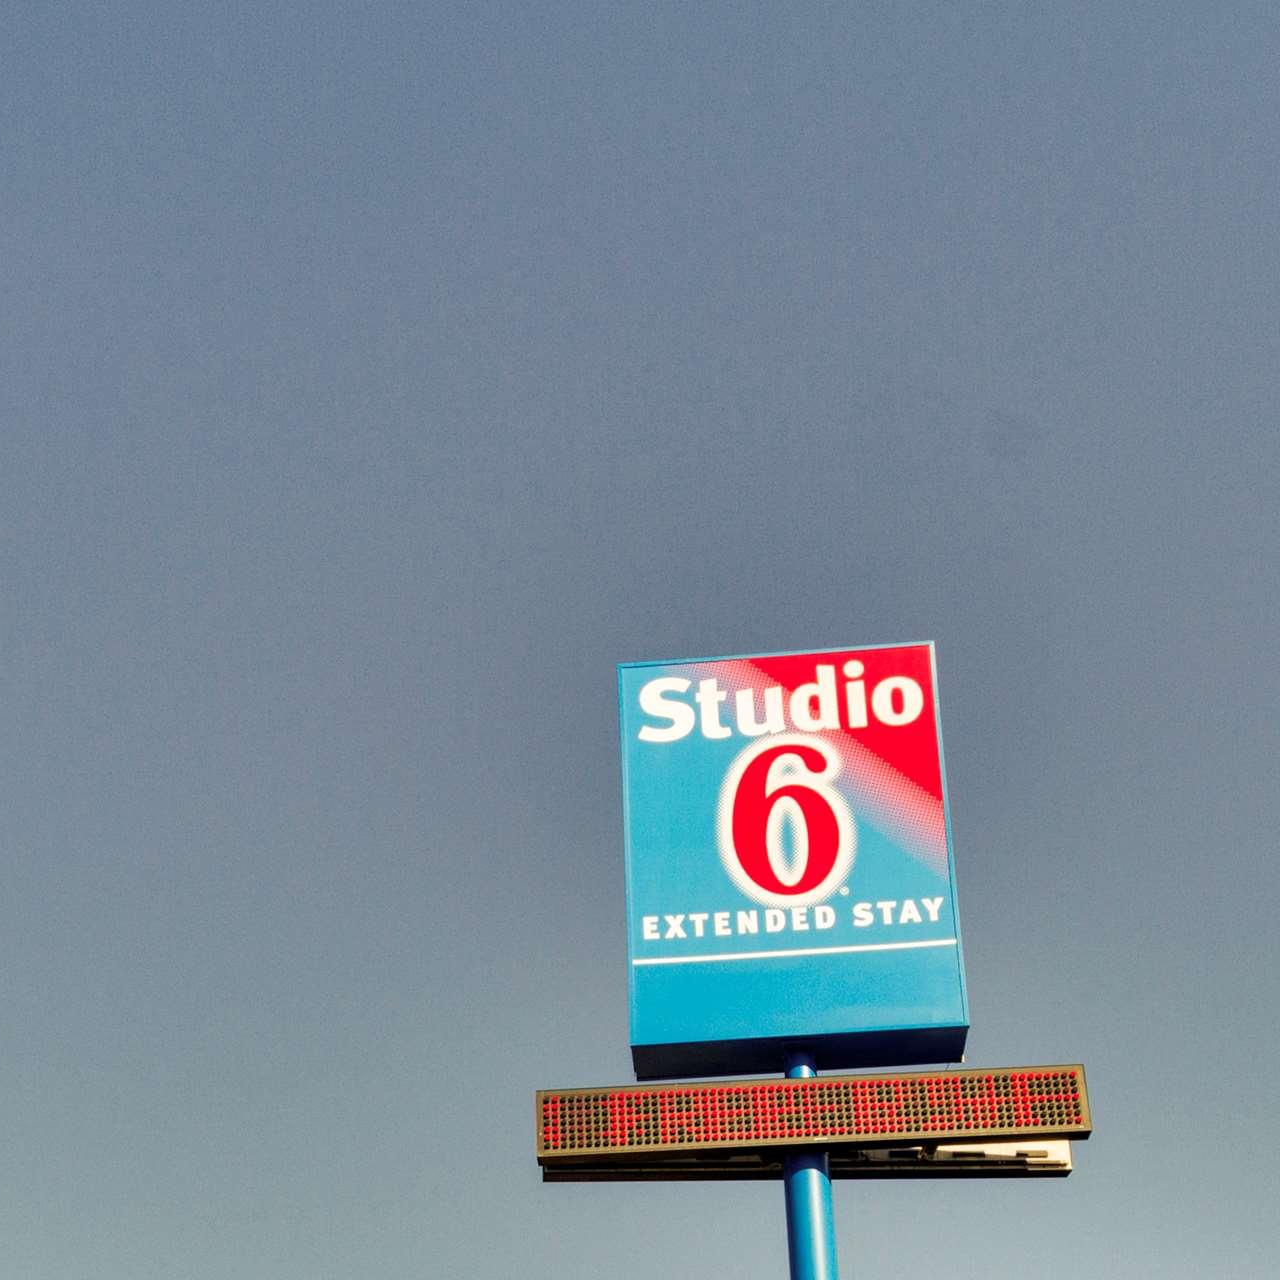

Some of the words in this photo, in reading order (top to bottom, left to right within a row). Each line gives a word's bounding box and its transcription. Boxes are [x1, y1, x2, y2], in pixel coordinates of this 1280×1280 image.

[638, 660, 924, 742] Studio
[730, 742, 844, 898] 6
[642, 904, 836, 940] EXTENDED
[852, 896, 945, 926] STAY
